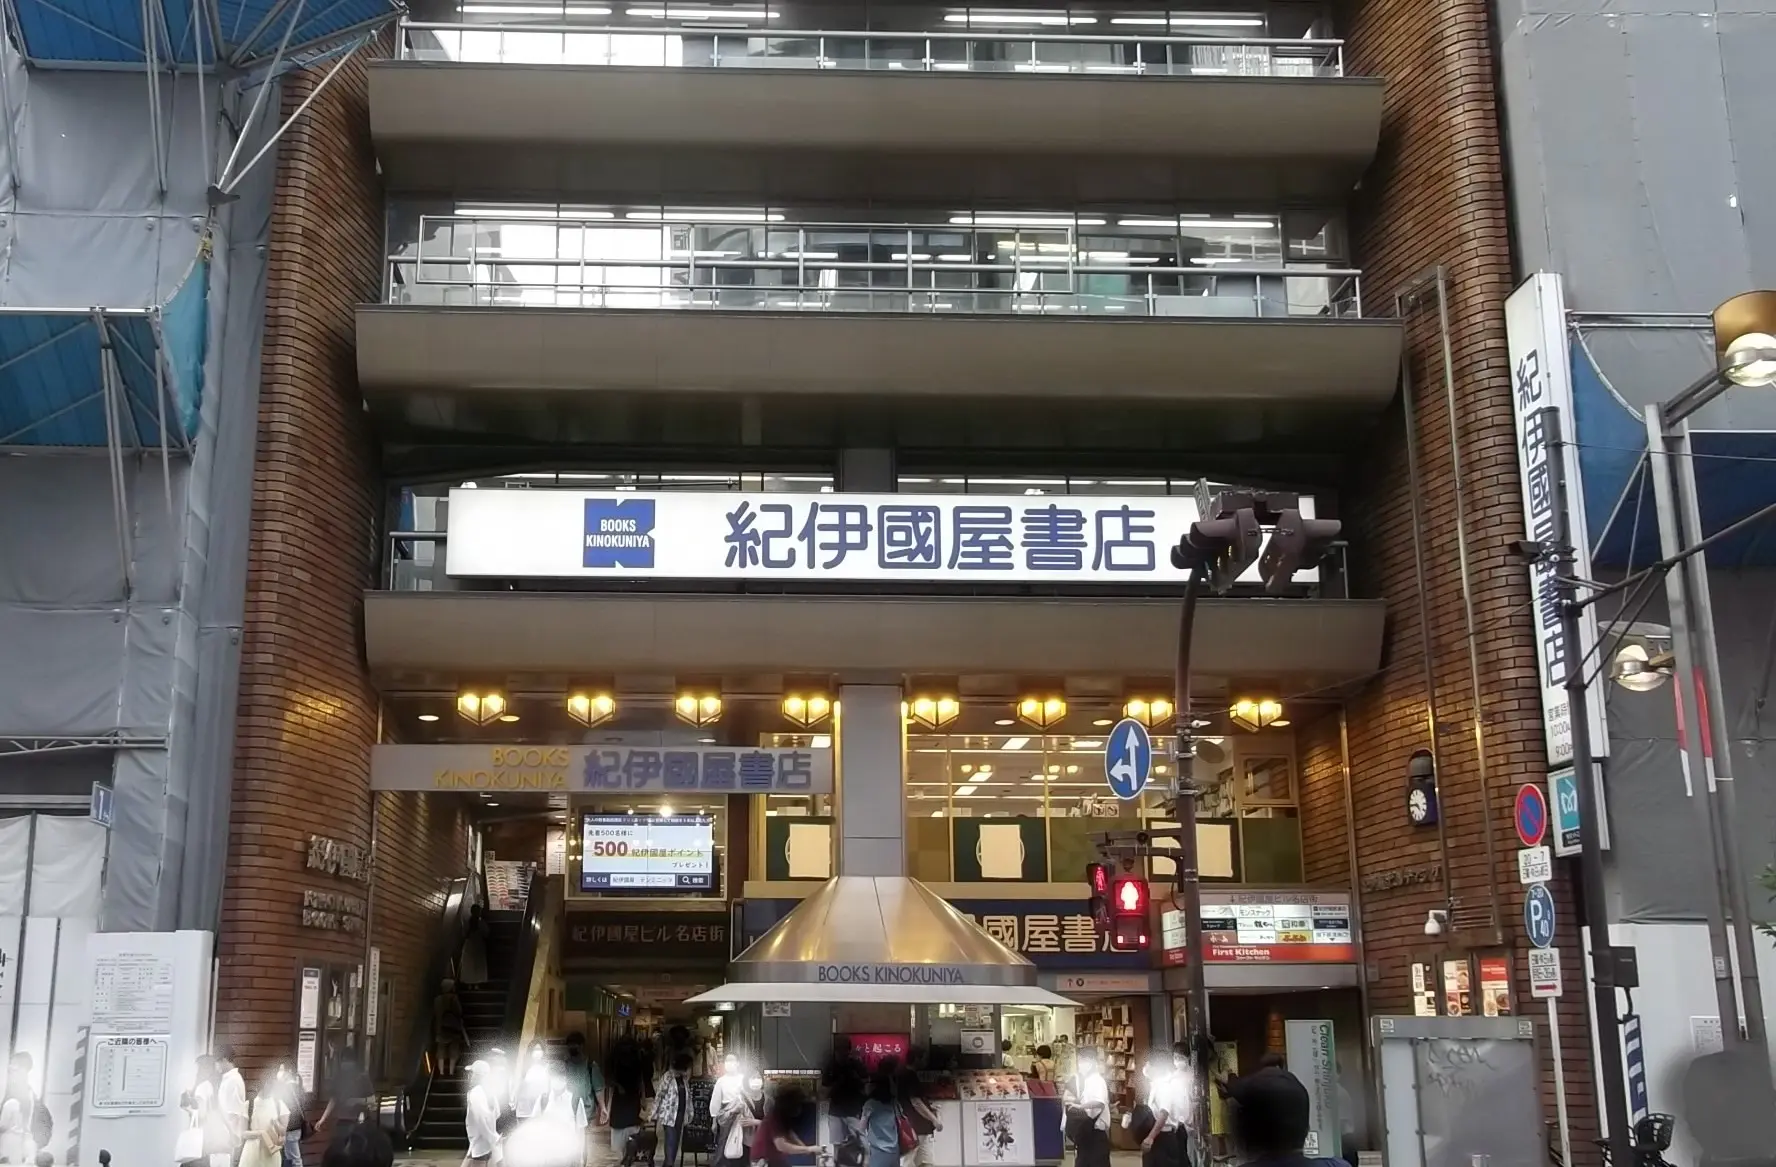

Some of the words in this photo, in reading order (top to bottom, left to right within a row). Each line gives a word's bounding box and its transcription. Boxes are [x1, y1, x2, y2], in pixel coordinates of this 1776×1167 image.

[600, 519, 637, 532] BOOKS
[585, 534, 650, 548] KINOKUNIYA
[724, 501, 1156, 571] 紀伊國屋書店
[491, 747, 570, 767] BOOKS
[583, 749, 812, 789] 紀伊國屋書店
[434, 769, 568, 789] KINOKUNIYA
[593, 840, 629, 857] 500
[1530, 899, 1543, 939] P
[1212, 948, 1234, 956] First
[1235, 948, 1270, 956] Kitchen
[818, 965, 870, 982] BOOKS
[875, 966, 964, 984] KINOKUNIYA
